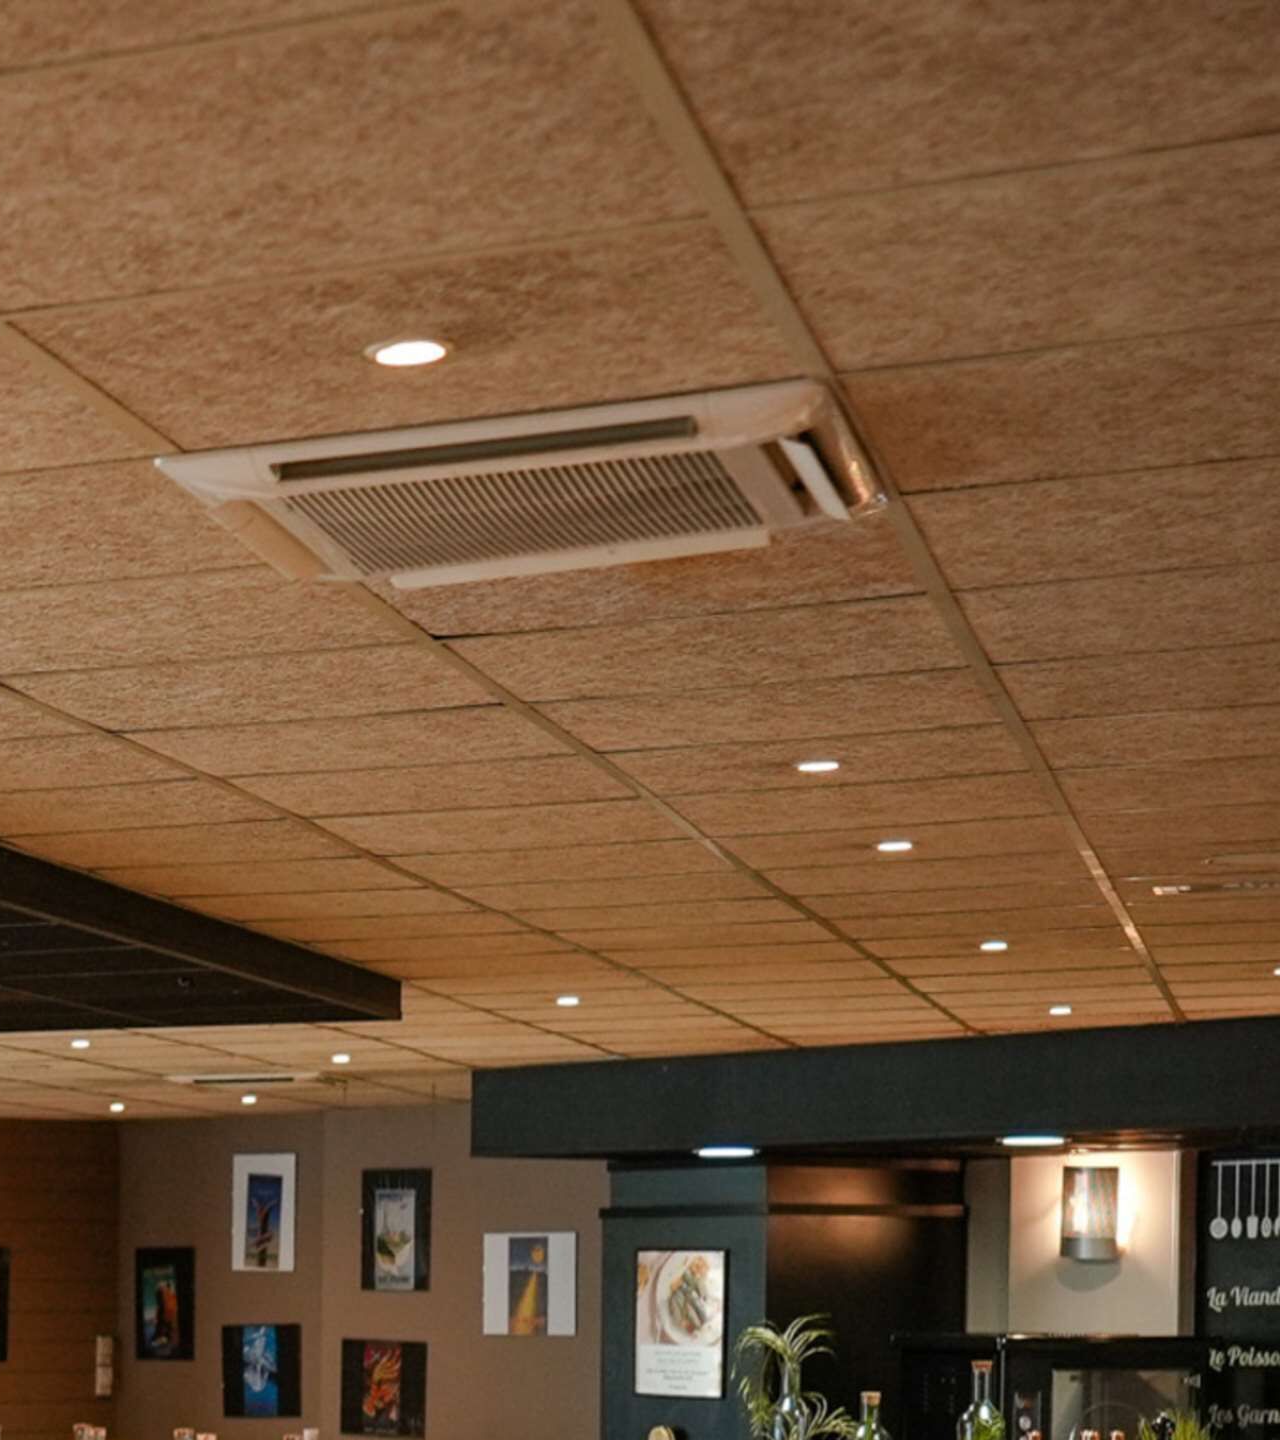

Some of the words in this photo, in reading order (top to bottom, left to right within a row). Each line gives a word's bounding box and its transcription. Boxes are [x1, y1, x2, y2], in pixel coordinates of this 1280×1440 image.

[1207, 1285, 1227, 1313] La
[1208, 1347, 1225, 1372] Le
[1208, 1403, 1233, 1429] Les
